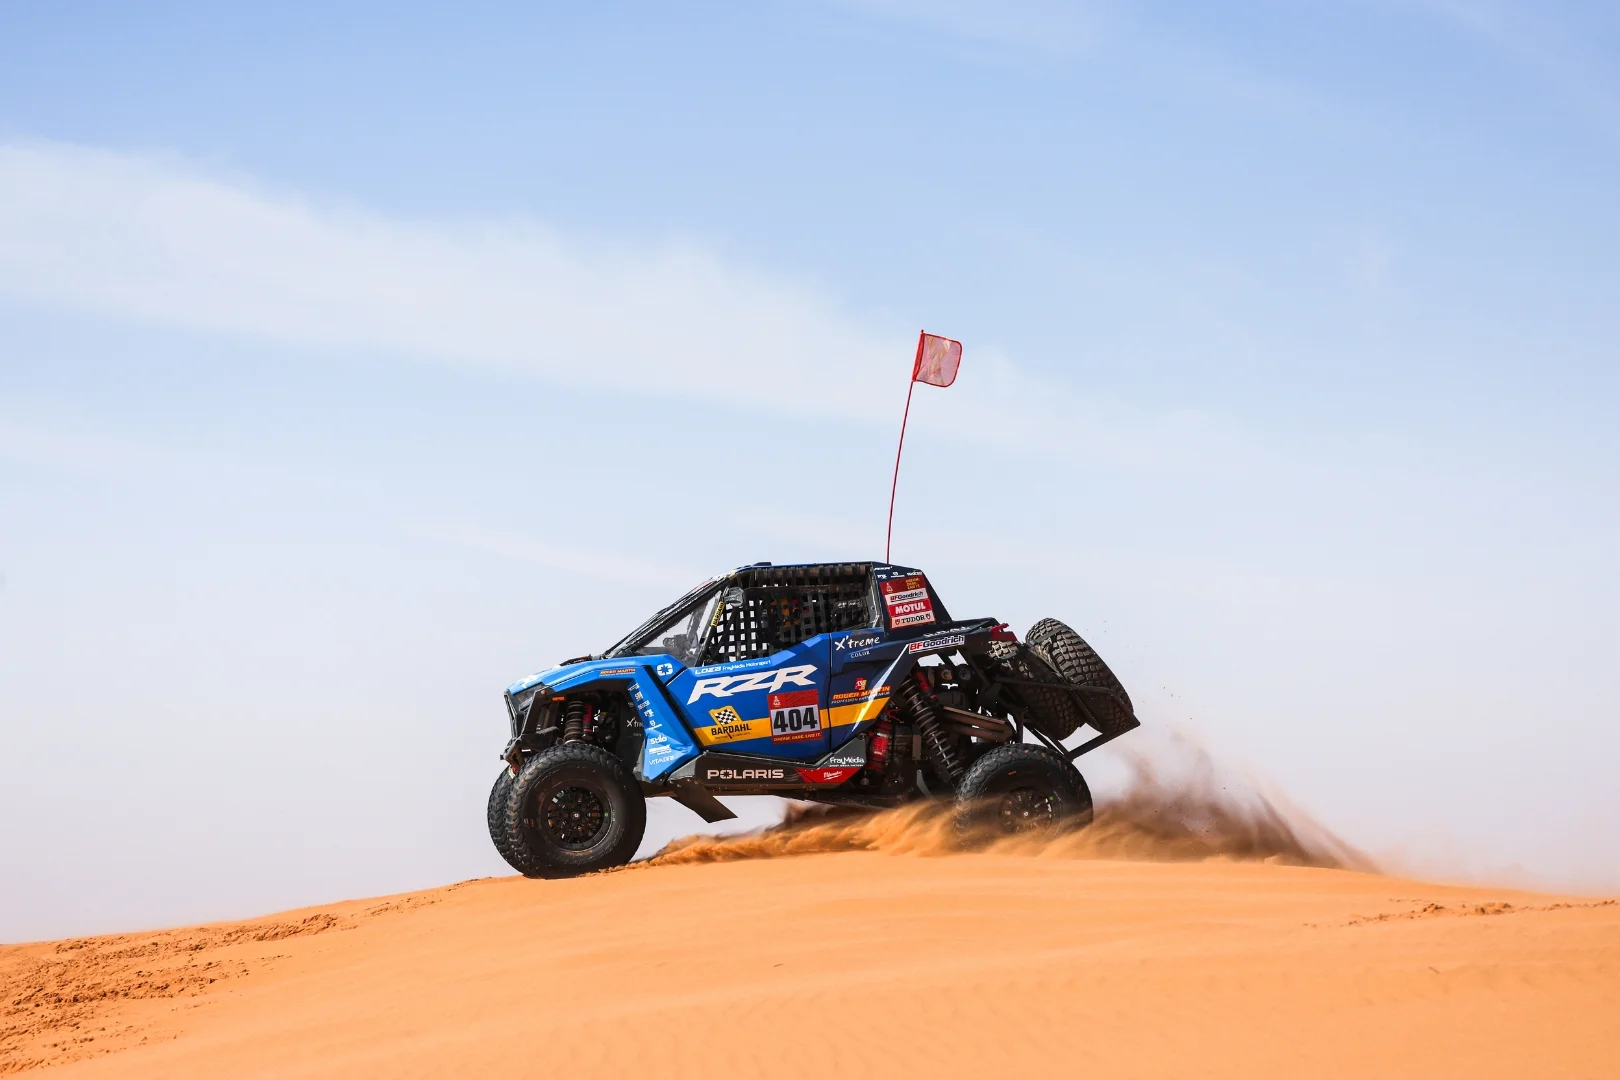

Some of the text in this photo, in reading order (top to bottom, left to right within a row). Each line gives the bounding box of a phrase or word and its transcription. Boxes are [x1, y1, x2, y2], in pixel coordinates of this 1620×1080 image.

[895, 602, 926, 614] MOTUL
[901, 615, 925, 624] TUDOR
[909, 635, 964, 651] BFGoodrich
[687, 664, 818, 705] RZR
[832, 692, 859, 700] ROGER
[774, 707, 818, 732] 404
[711, 723, 752, 736] BARDAHL
[707, 769, 784, 780] POLARIS
